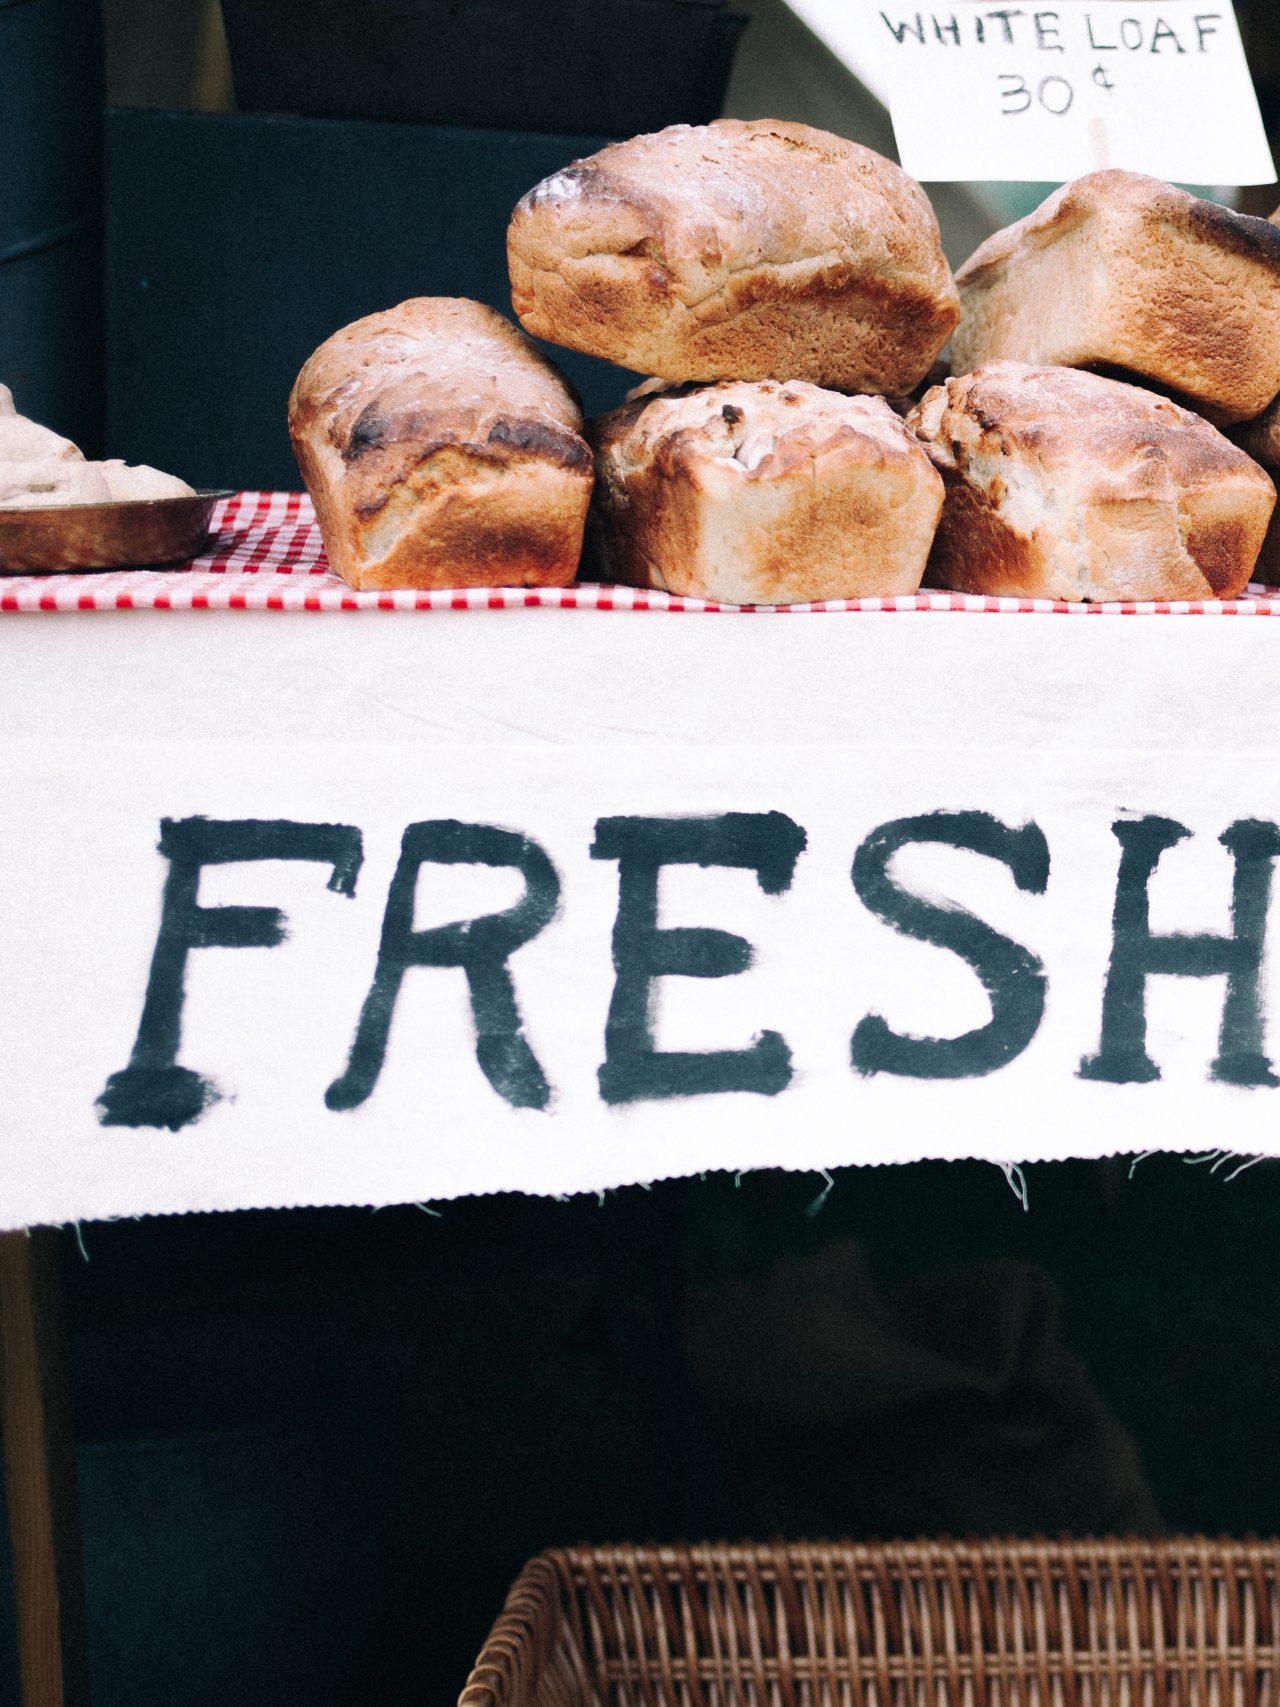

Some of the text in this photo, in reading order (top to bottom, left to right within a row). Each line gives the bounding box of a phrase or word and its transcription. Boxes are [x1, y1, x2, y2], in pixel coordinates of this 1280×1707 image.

[880, 9, 1223, 54] WHITE LOAF
[997, 73, 1074, 116] 30
